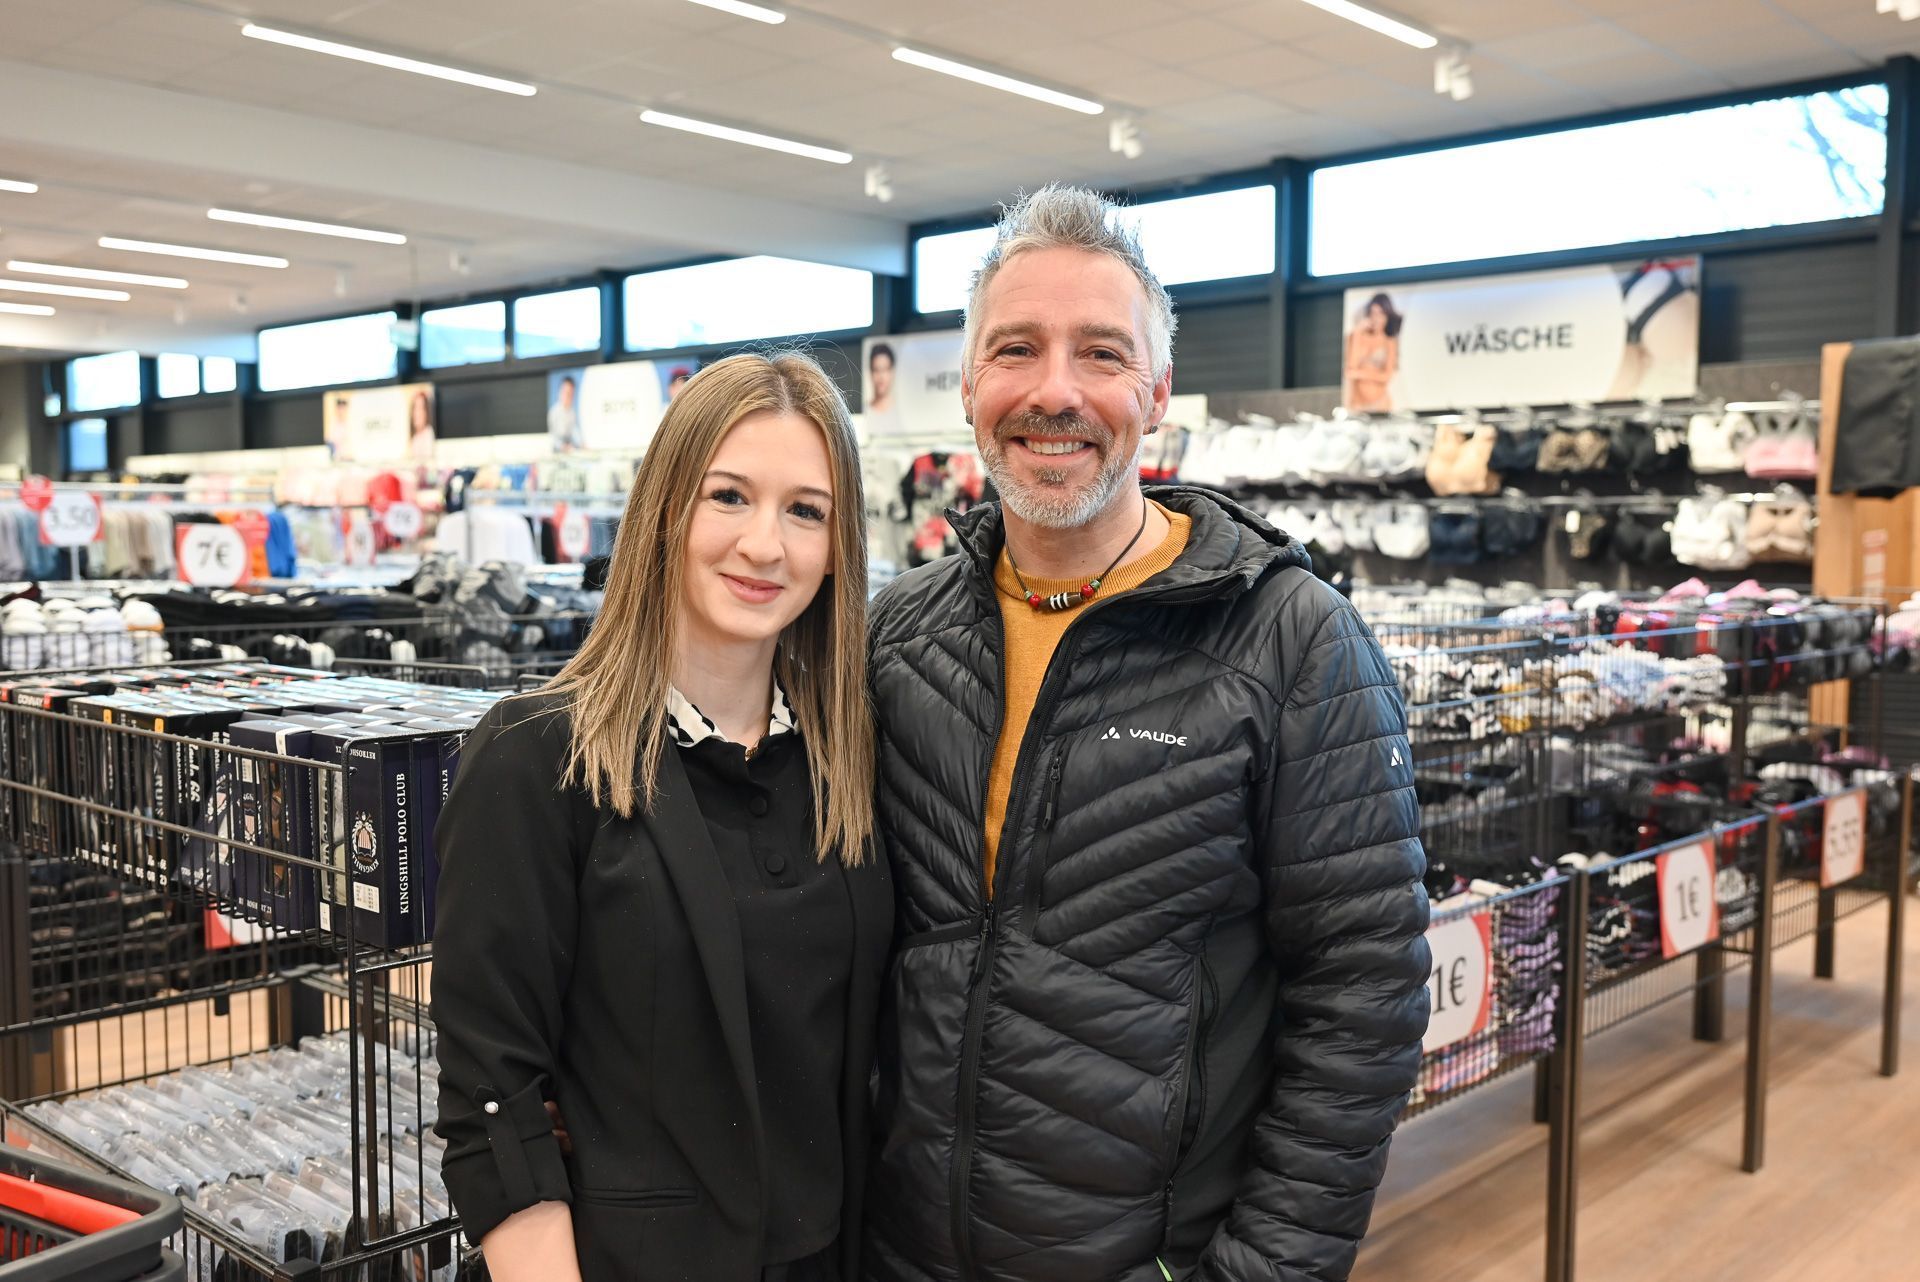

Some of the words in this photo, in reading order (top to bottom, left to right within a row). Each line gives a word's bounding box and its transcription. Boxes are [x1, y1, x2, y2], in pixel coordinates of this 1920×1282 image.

[1445, 322, 1574, 355] WÄSCHE
[925, 369, 962, 392] HER
[197, 536, 231, 570] 7€
[350, 747, 376, 760] RETROSHO
[1129, 727, 1188, 747] VAUDE
[396, 772, 407, 807] CLUB
[396, 808, 408, 844] POLO
[397, 845, 410, 915] KINGSHILL
[1676, 874, 1700, 921] 1€
[1431, 956, 1466, 1014] 1€
